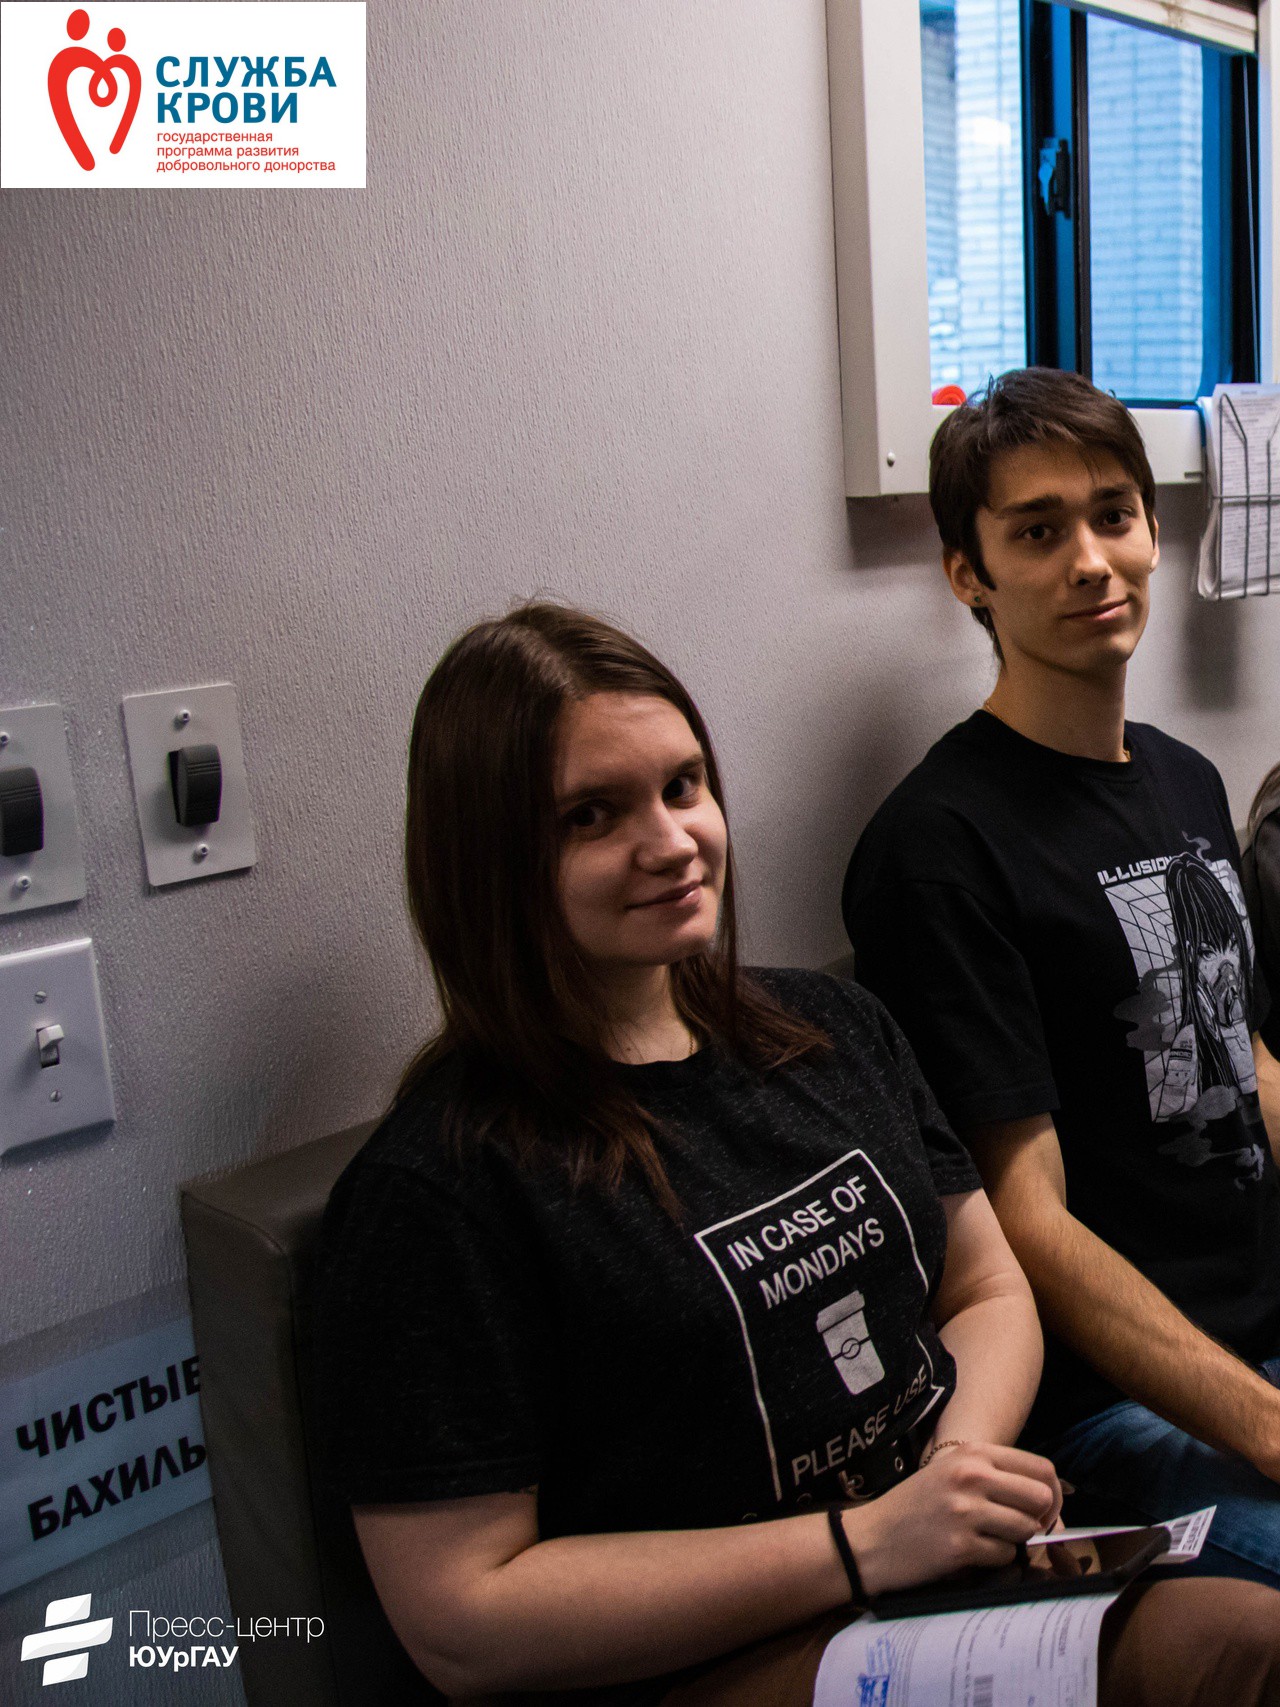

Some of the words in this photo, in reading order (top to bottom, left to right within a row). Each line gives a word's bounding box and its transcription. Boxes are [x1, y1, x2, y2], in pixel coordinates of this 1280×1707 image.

[727, 1235, 763, 1271] IN
[761, 1200, 836, 1252] CASE
[831, 1176, 868, 1213] OF
[758, 1218, 885, 1310] MONDAYS
[791, 1403, 889, 1486] PLEASE
[893, 1362, 928, 1415] USE
